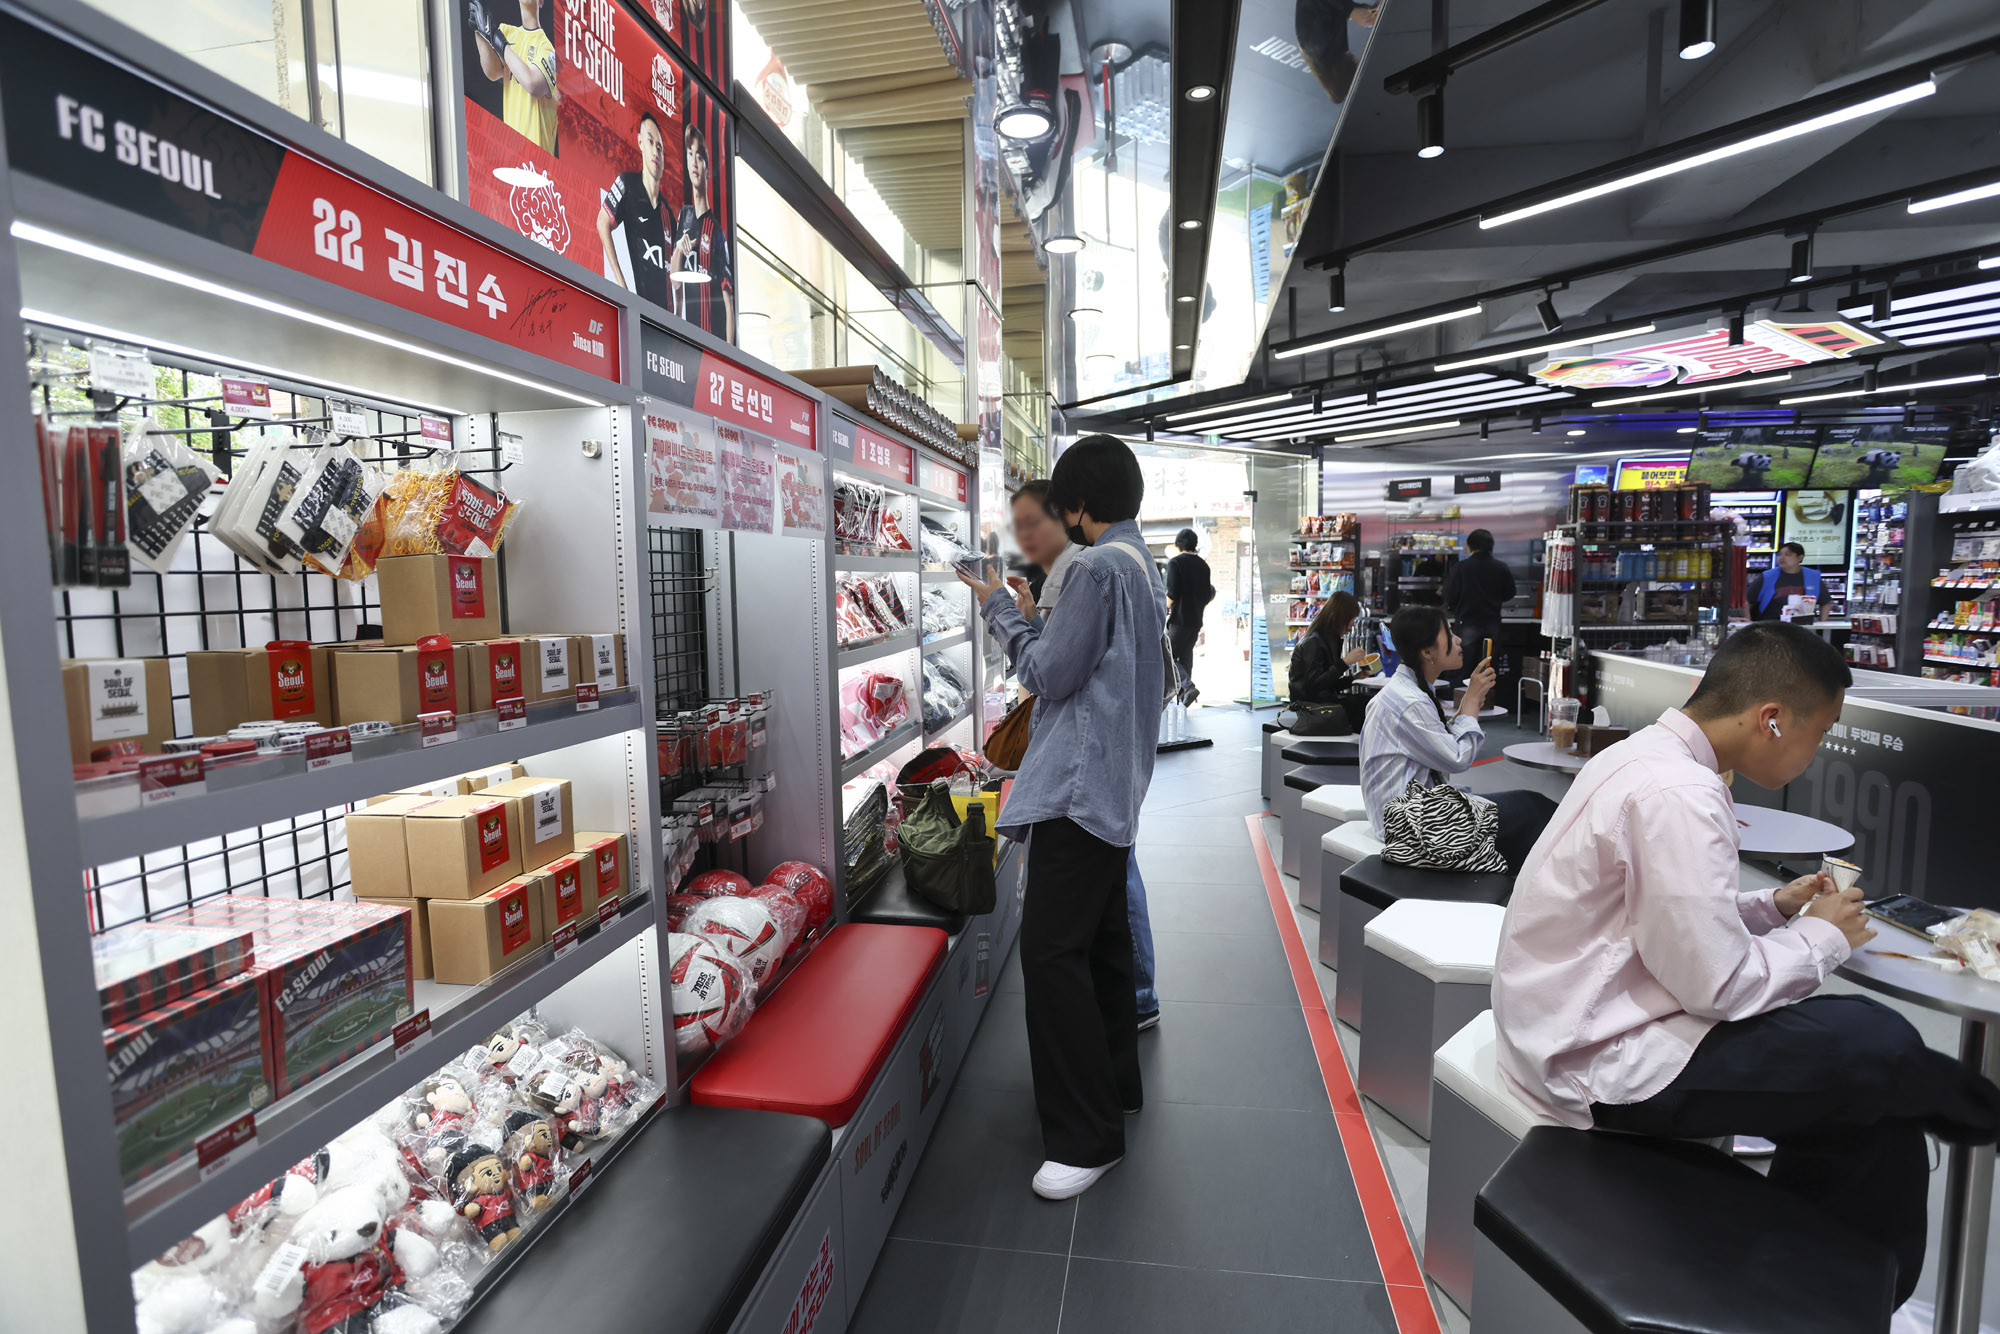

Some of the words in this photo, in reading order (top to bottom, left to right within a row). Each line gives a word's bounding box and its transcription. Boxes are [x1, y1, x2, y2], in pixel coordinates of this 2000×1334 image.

[564, 10, 583, 70] FC
[584, 31, 626, 108] SEOUL
[55, 94, 105, 153] FC
[113, 120, 222, 200] SEOUL
[313, 197, 364, 272] 22
[384, 228, 508, 320] 김진수
[588, 319, 604, 336] DF
[647, 351, 657, 374] FC
[659, 355, 686, 384] SEOUL
[709, 371, 725, 406] 27
[731, 379, 774, 424] 문선민
[648, 415, 657, 428] FC
[657, 417, 678, 433] SEOUL
[861, 437, 866, 460] 9
[461, 488, 486, 512] SOUL
[484, 505, 498, 520] OF
[455, 573, 477, 590] Seoul
[278, 670, 304, 688] Seoul
[425, 670, 449, 688] Seoul
[495, 663, 515, 680] Seoul
[104, 679, 122, 690] SOUL
[123, 677, 133, 688] OF
[107, 688, 133, 699] SEOUL
[1850, 727, 1881, 747] 두번째
[1882, 734, 1904, 752] 우승
[483, 824, 502, 844] Seoul
[600, 857, 615, 872] Seoul
[559, 879, 577, 897] Seoul
[504, 908, 524, 926] Seoul
[274, 991, 294, 1012] FC
[294, 949, 335, 993] SEOUL
[690, 971, 706, 993] SEOUL
[700, 990, 708, 1001] OF
[855, 1140, 873, 1176] SOUL
[874, 1126, 882, 1152] OF
[800, 1261, 819, 1313] 가는
[820, 1233, 830, 1271] 길
